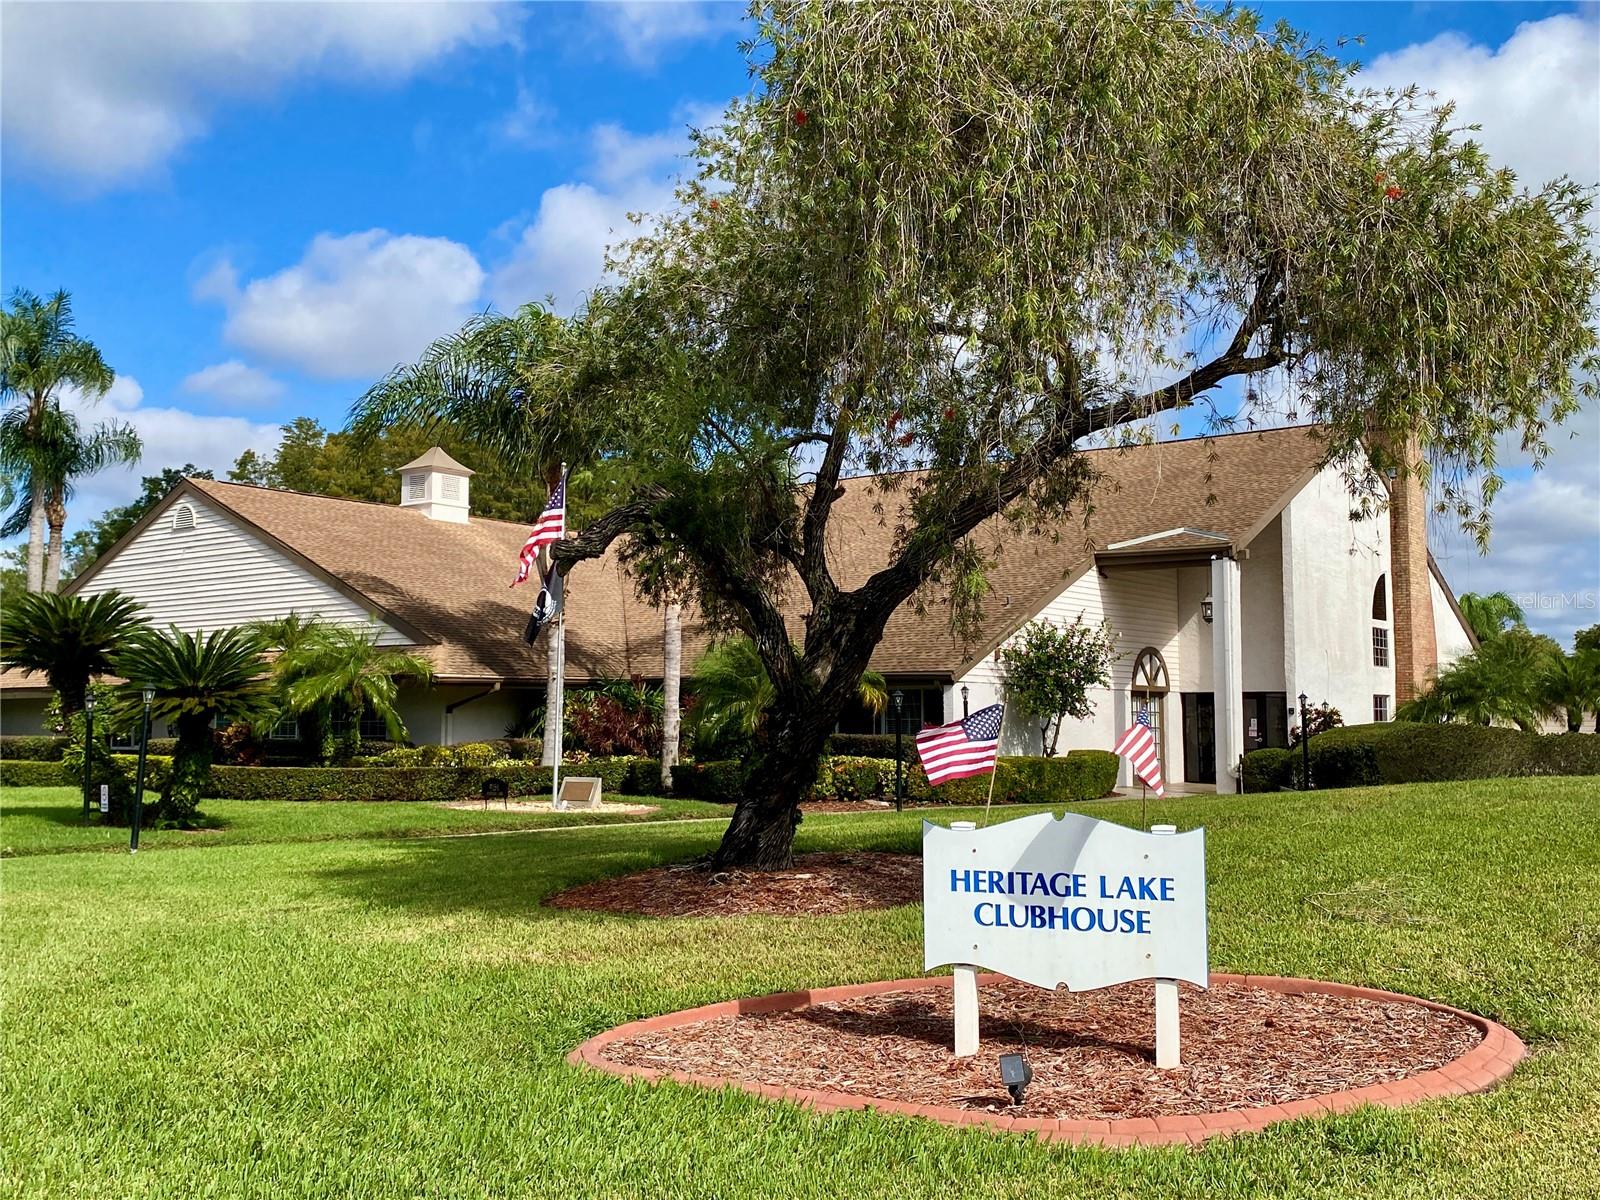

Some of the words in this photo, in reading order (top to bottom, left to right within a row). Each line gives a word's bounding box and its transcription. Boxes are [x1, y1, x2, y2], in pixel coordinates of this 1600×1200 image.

[950, 869, 1086, 898] HERITAGE
[1100, 875, 1175, 902] LAKE
[973, 902, 1151, 934] CLUBHOUSE
